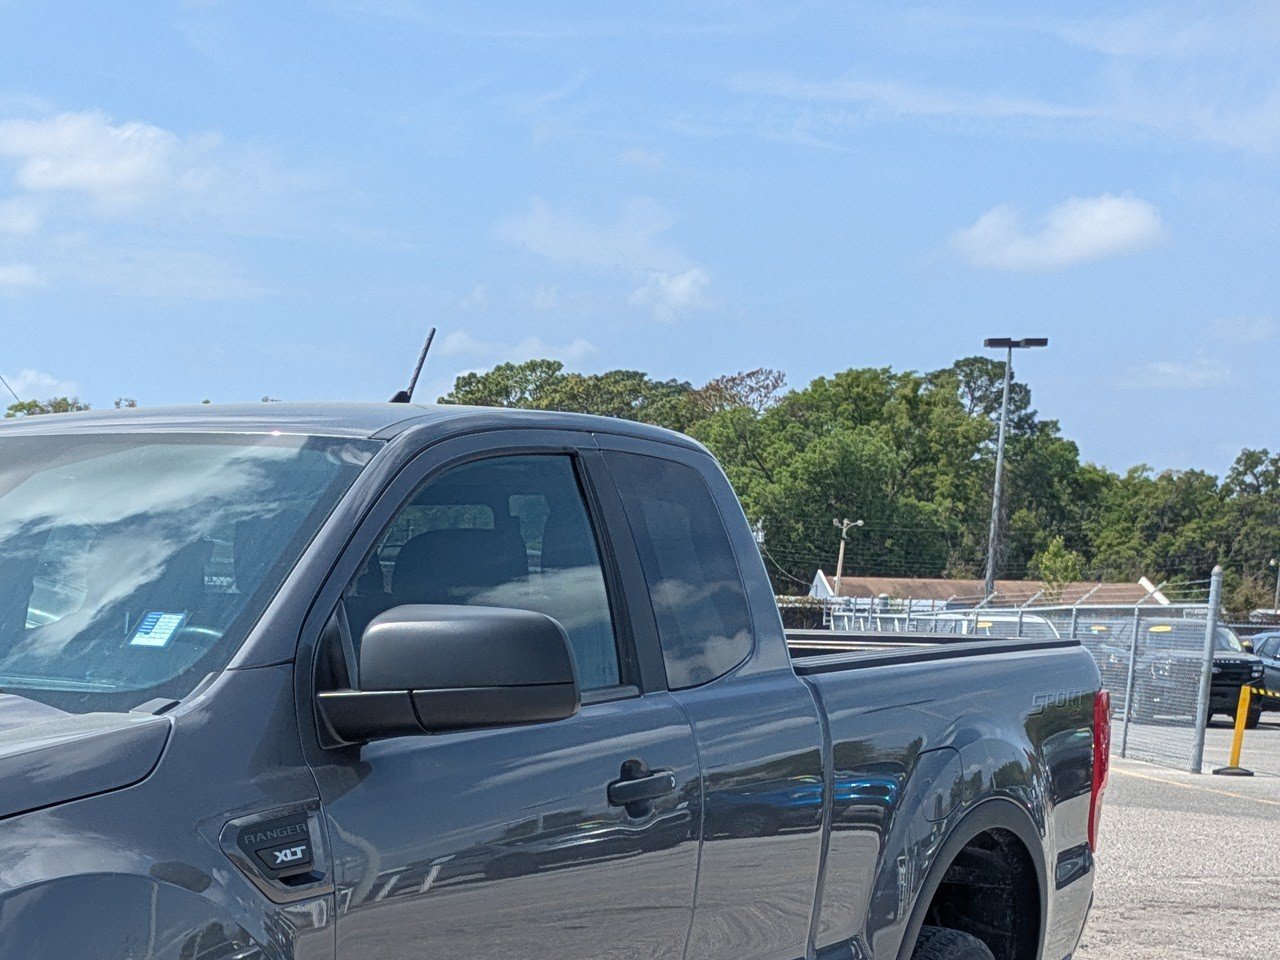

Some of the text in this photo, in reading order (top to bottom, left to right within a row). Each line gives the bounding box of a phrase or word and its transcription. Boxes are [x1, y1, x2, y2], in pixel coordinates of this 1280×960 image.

[1027, 690, 1089, 717] SPORT
[244, 823, 307, 845] RANGER
[273, 845, 307, 864] XLT
